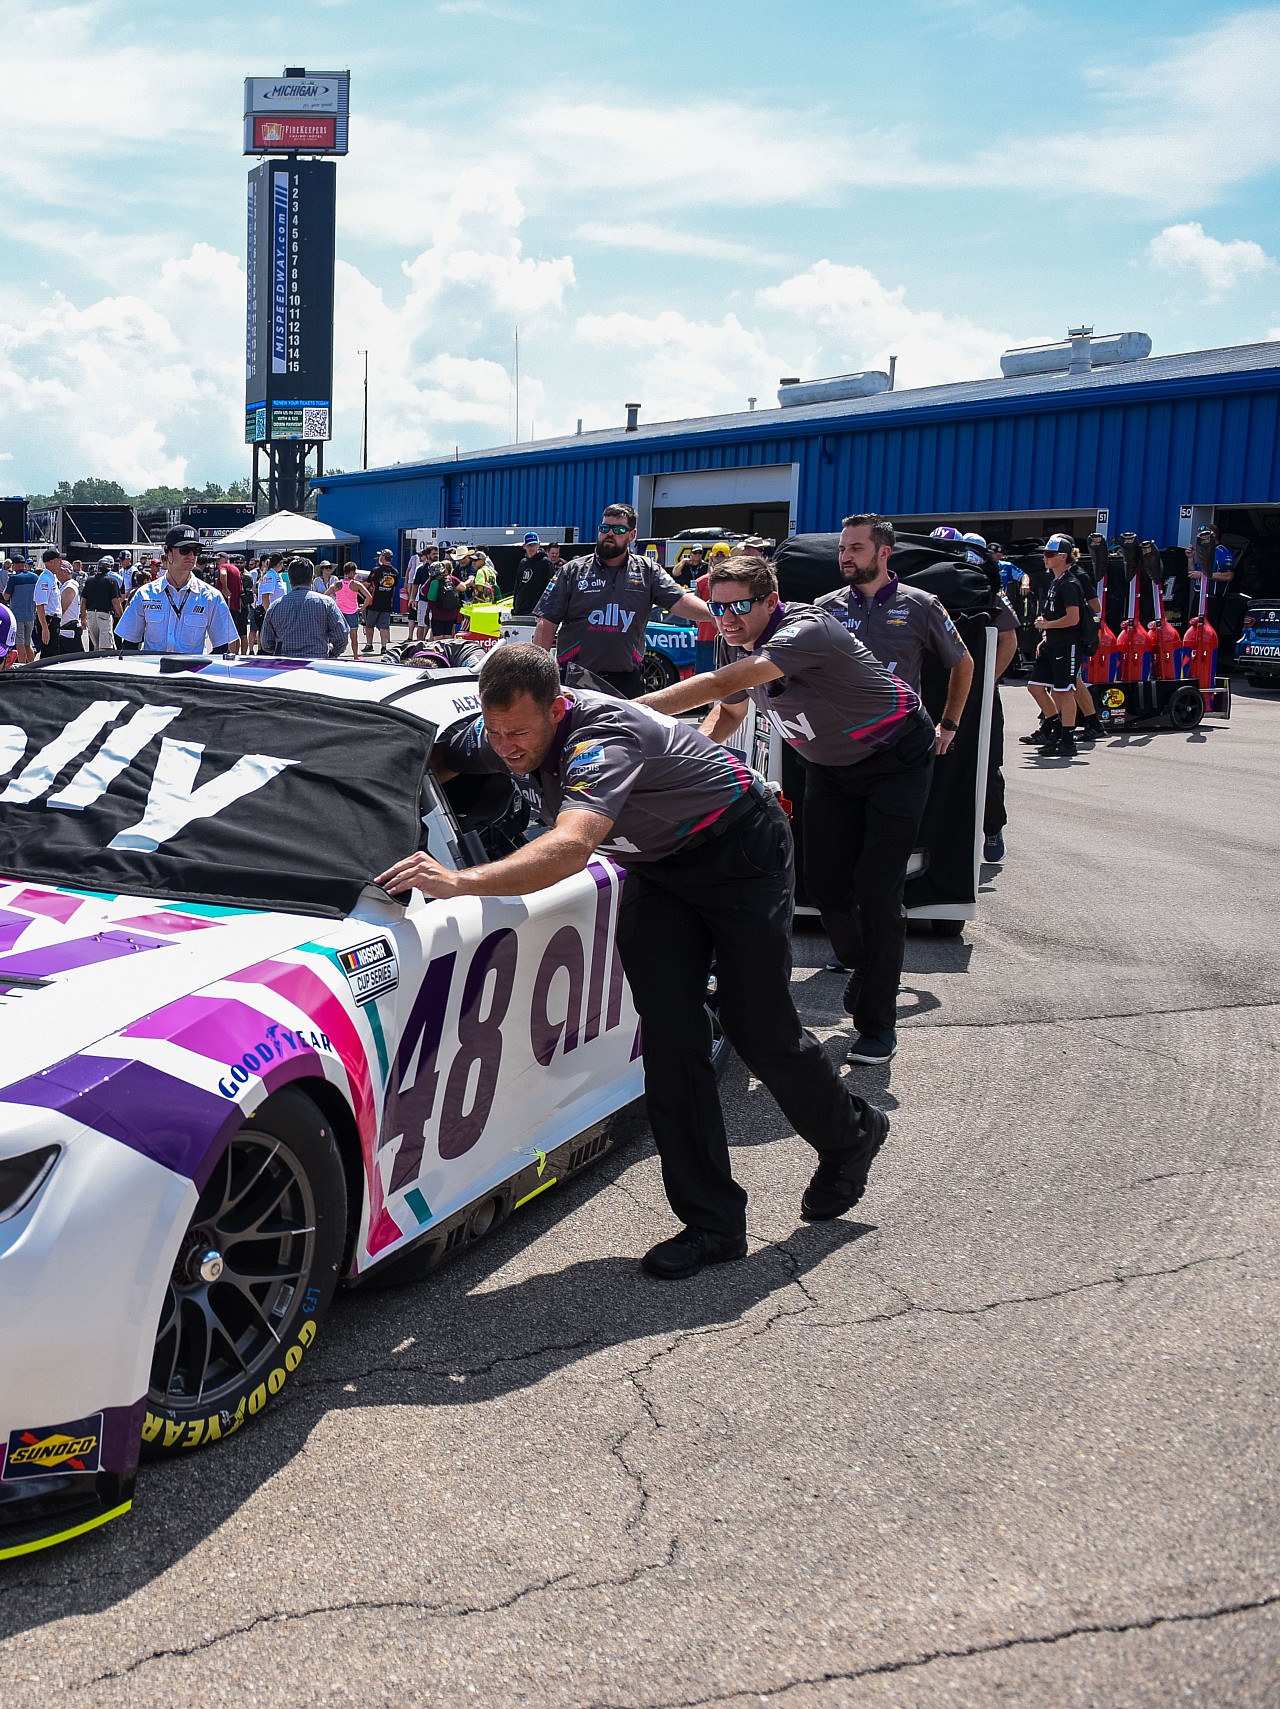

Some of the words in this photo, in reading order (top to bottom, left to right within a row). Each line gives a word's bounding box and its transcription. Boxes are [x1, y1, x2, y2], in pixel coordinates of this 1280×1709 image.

[271, 85, 319, 97] MICHIGAN
[293, 174, 299, 185] 1
[292, 187, 299, 198] 2
[292, 201, 299, 212] 3
[292, 214, 299, 226] 4
[292, 228, 299, 239] 5
[292, 241, 298, 252] 6
[292, 254, 298, 266] 7
[292, 268, 298, 280] 8
[291, 281, 298, 292] 9
[289, 294, 300, 306] 10
[289, 308, 300, 319] 11
[288, 321, 300, 332] 12
[288, 334, 300, 346] 13
[288, 348, 300, 359] 14
[288, 361, 300, 372] 15
[1099, 513, 1107, 522] 51
[1181, 508, 1192, 517] 50
[591, 579, 606, 588] ally
[588, 603, 635, 633] ally
[1250, 646, 1280, 657] TOYOTA
[766, 708, 816, 742] lly
[357, 942, 387, 966] NASCAR
[357, 973, 371, 991] CUP
[371, 964, 392, 986] SERIES
[380, 927, 519, 1195] 48
[302, 1287, 320, 1313] LF3
[12, 1439, 94, 1462] SUNOCO
